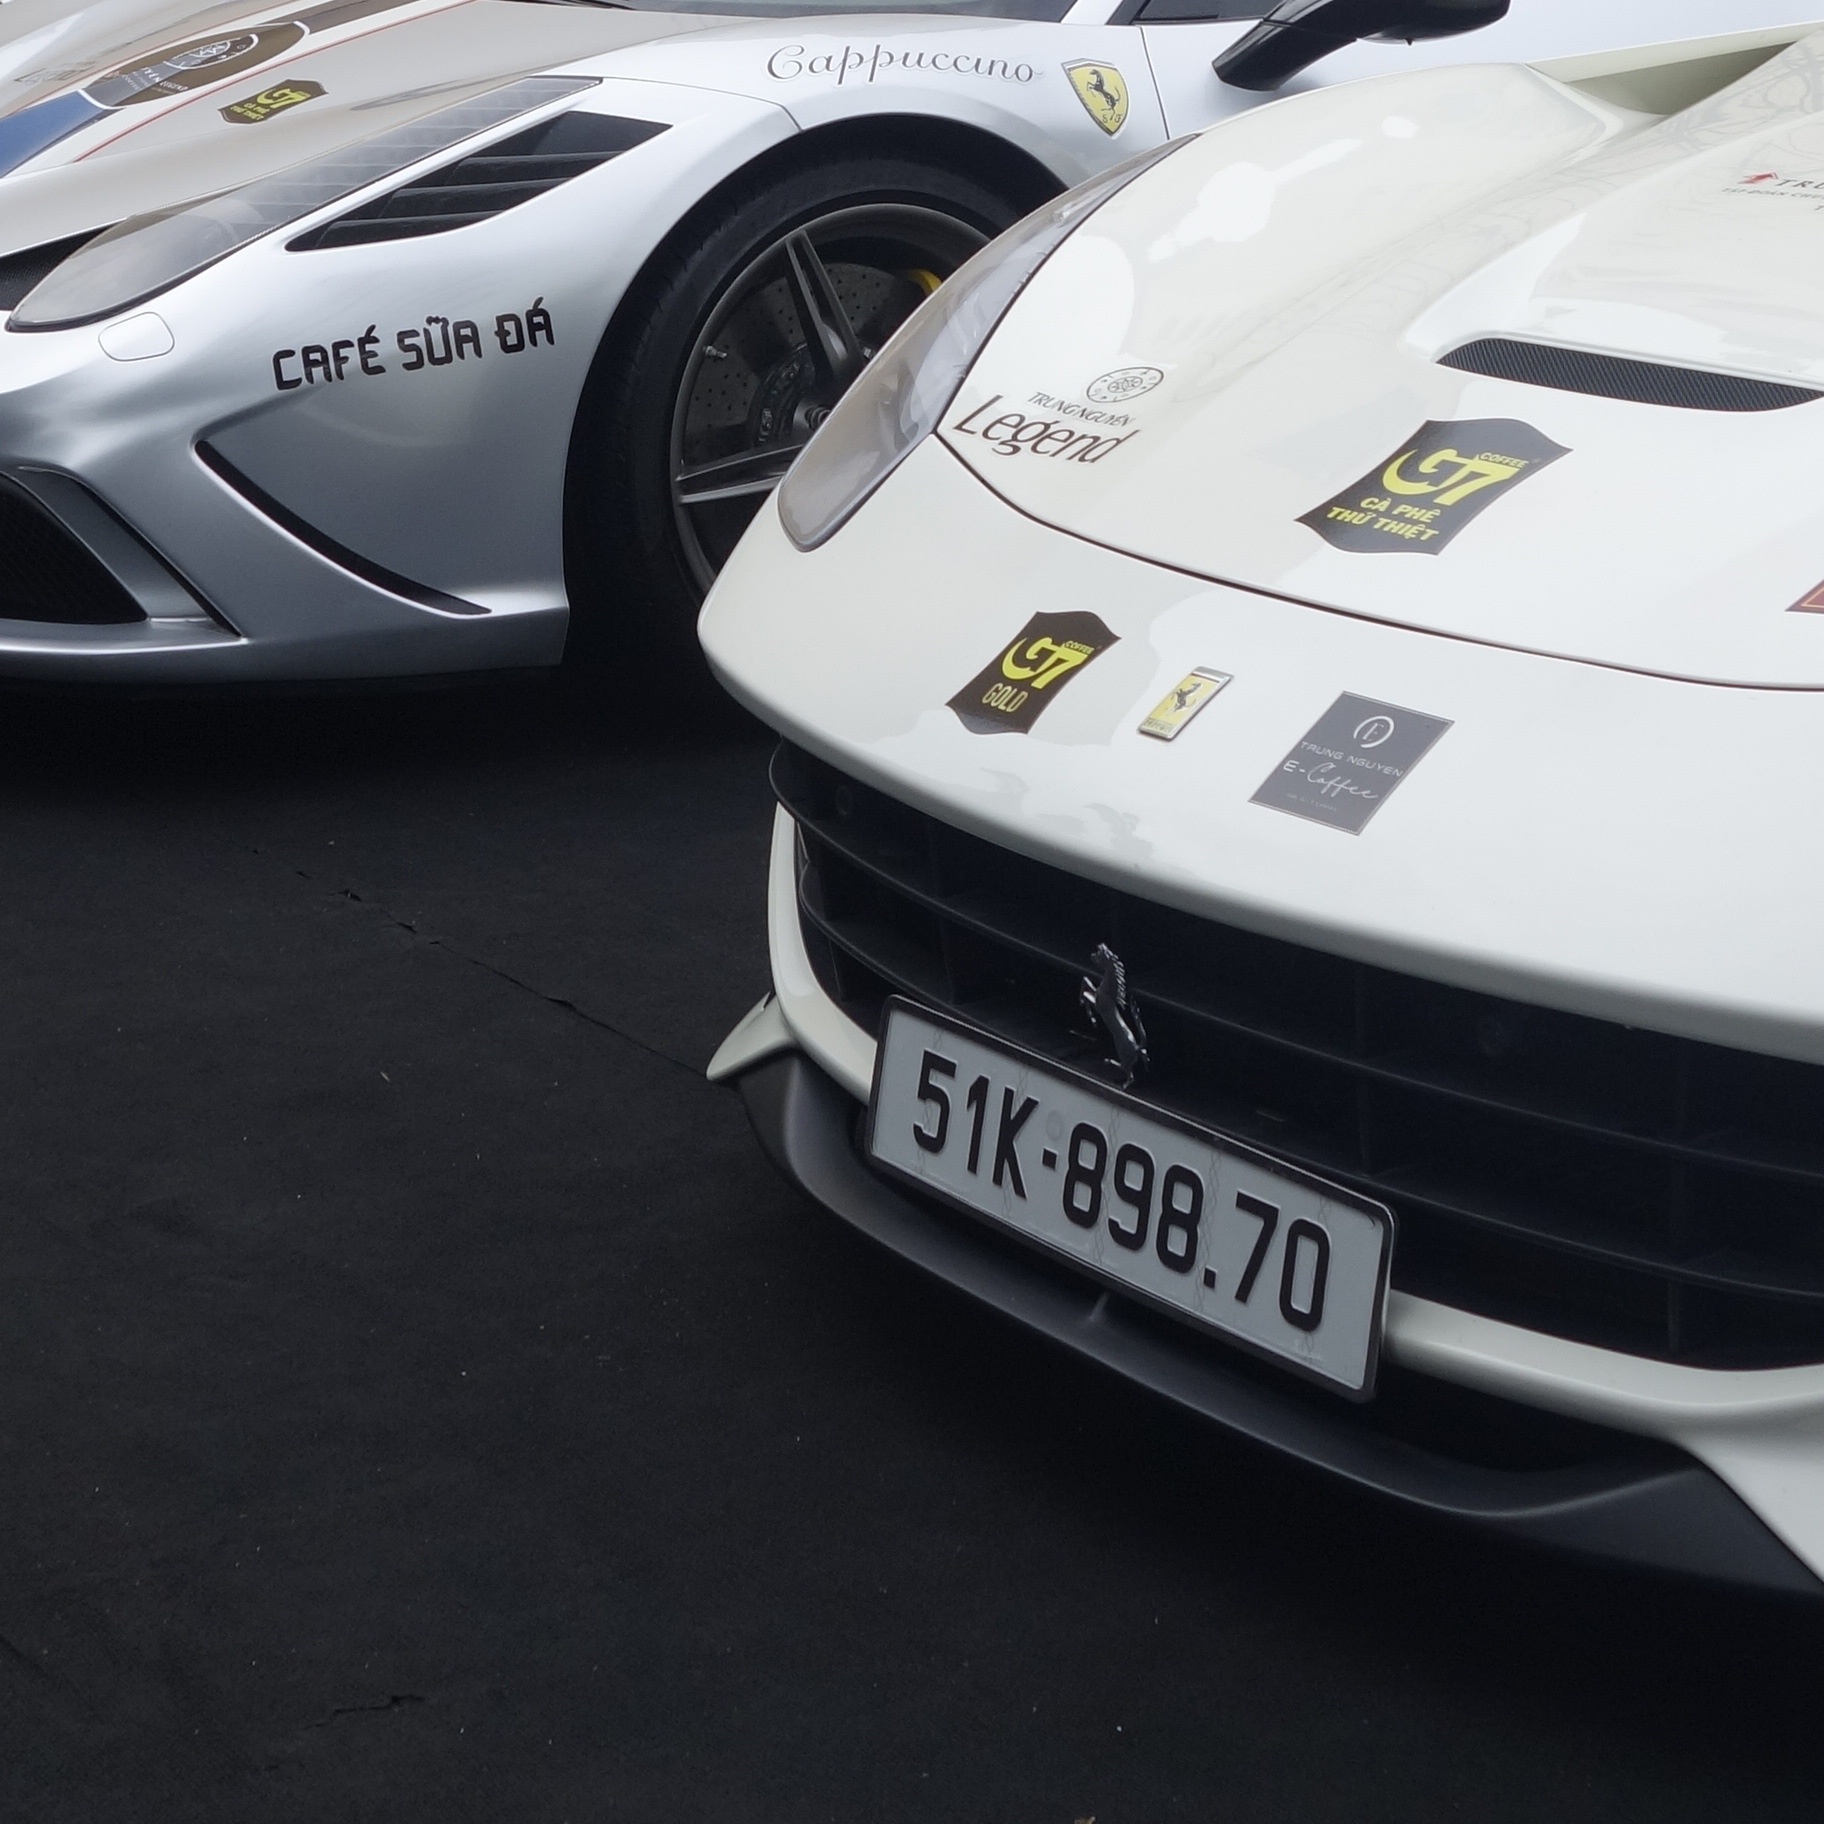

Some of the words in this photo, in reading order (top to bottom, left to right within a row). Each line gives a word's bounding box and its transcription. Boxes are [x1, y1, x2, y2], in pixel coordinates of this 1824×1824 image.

[767, 44, 1042, 86] Cappuccino
[272, 324, 386, 391] CAFÉ
[396, 316, 483, 371] SỮA
[494, 296, 555, 354] ĐÁ
[1027, 392, 1078, 415] TRUNG
[953, 394, 1141, 464] Legend
[1383, 448, 1521, 506] G7
[1479, 452, 1529, 468] COFFEE
[1326, 507, 1374, 526] THỨ
[1374, 517, 1439, 541] THIỆT
[1360, 496, 1392, 511] CÀ
[1393, 504, 1441, 523] PHÊ
[1002, 637, 1089, 689] G7
[1065, 640, 1095, 654] COFFEE
[982, 682, 1029, 713] GOLD
[1300, 741, 1345, 760] TRUNG
[1346, 755, 1404, 777] NGUYEN
[911, 1050, 1331, 1333] 51K-898.70
